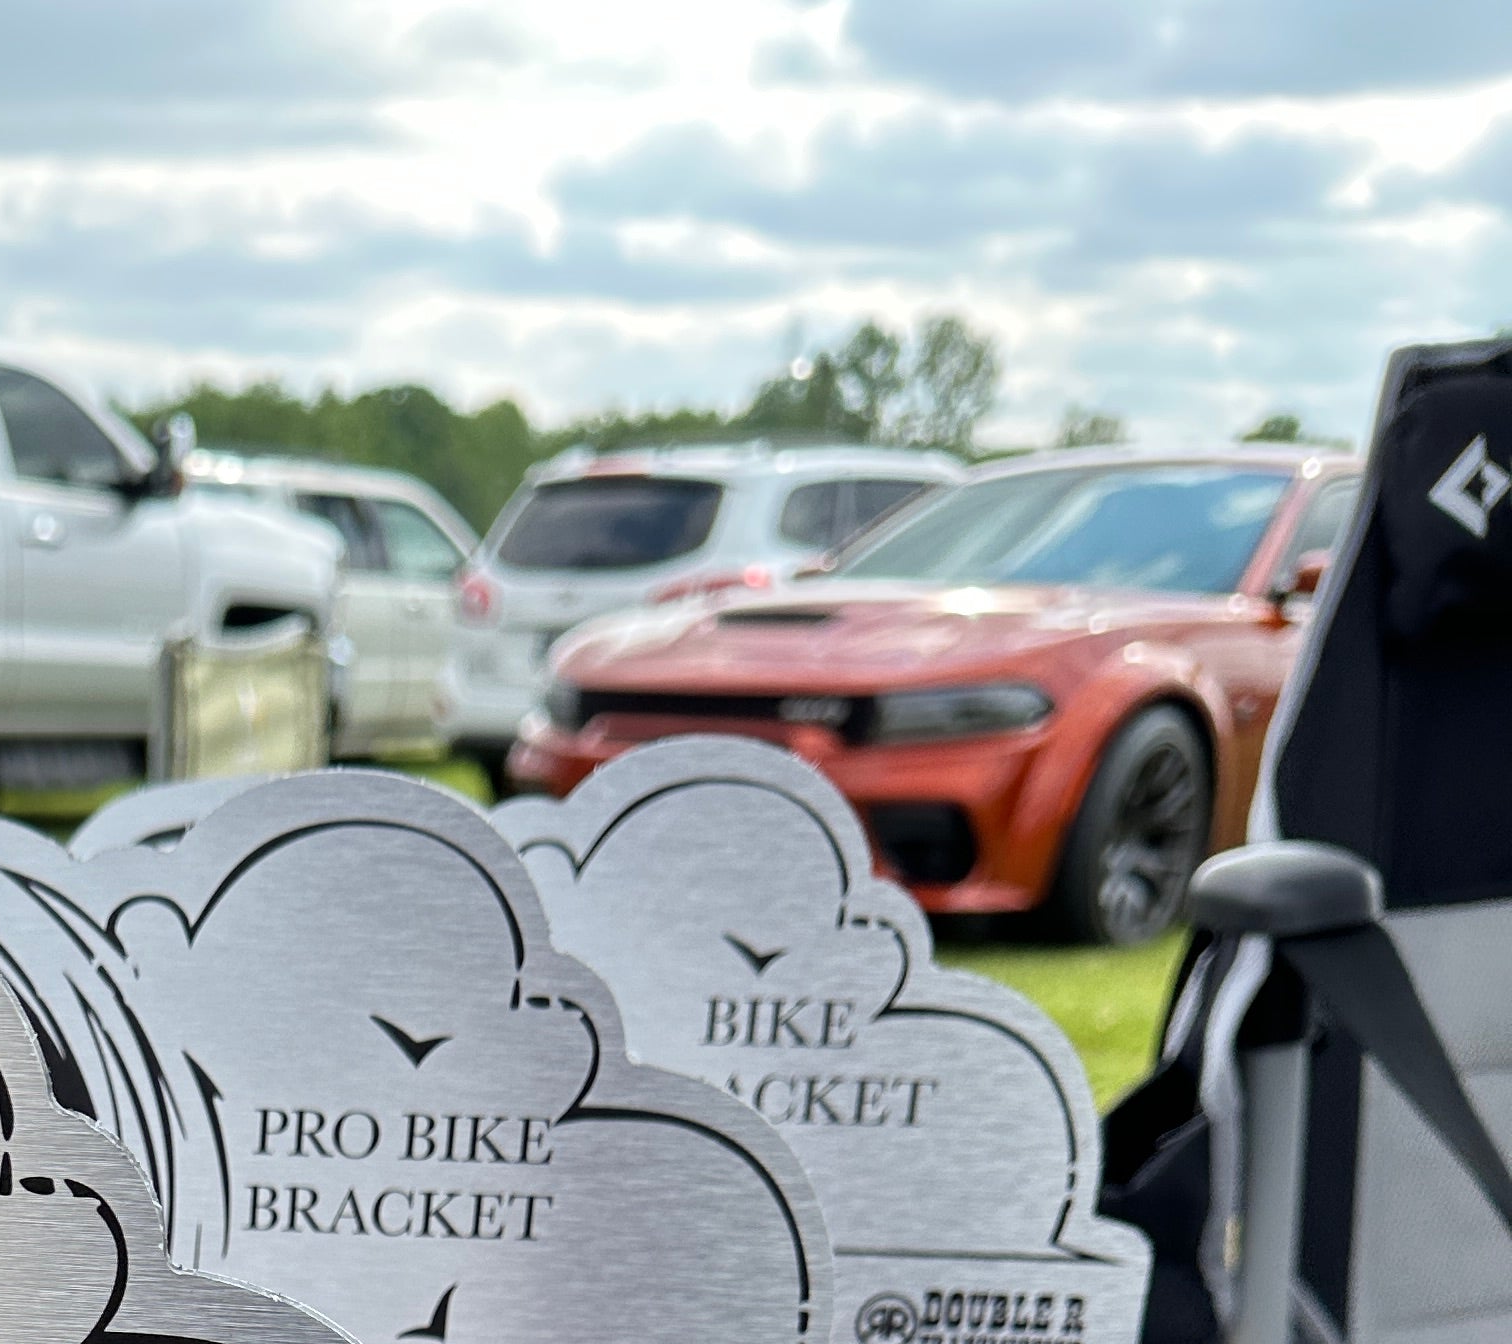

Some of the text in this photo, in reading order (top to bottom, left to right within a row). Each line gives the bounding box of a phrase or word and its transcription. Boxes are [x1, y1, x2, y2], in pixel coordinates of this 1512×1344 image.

[699, 995, 857, 1049] BIKE
[254, 1108, 554, 1165] PRO BIKE
[243, 1184, 554, 1242] BRACKET
[922, 1290, 1053, 1331] DOUBLE
